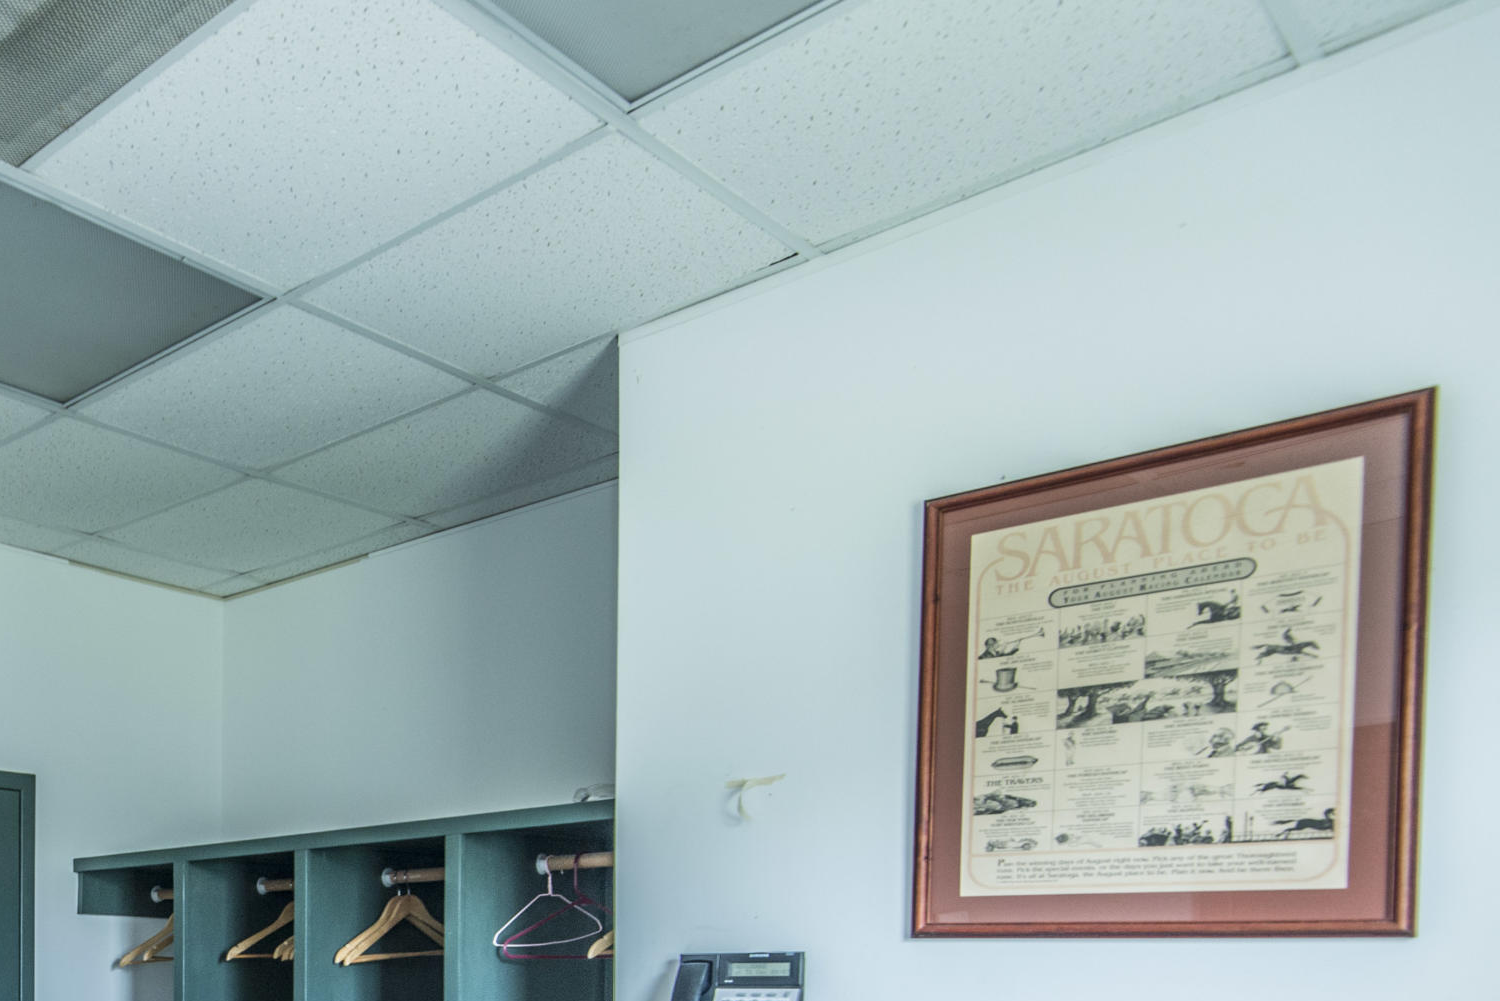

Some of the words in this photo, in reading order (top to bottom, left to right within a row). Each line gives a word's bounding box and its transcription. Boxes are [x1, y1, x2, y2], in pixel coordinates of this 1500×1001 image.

[996, 579, 1034, 595] THE
[1049, 563, 1132, 587] AUGUST
[1153, 547, 1228, 569] PLACE
[1247, 538, 1277, 552] TO
[1297, 529, 1326, 544] BE
